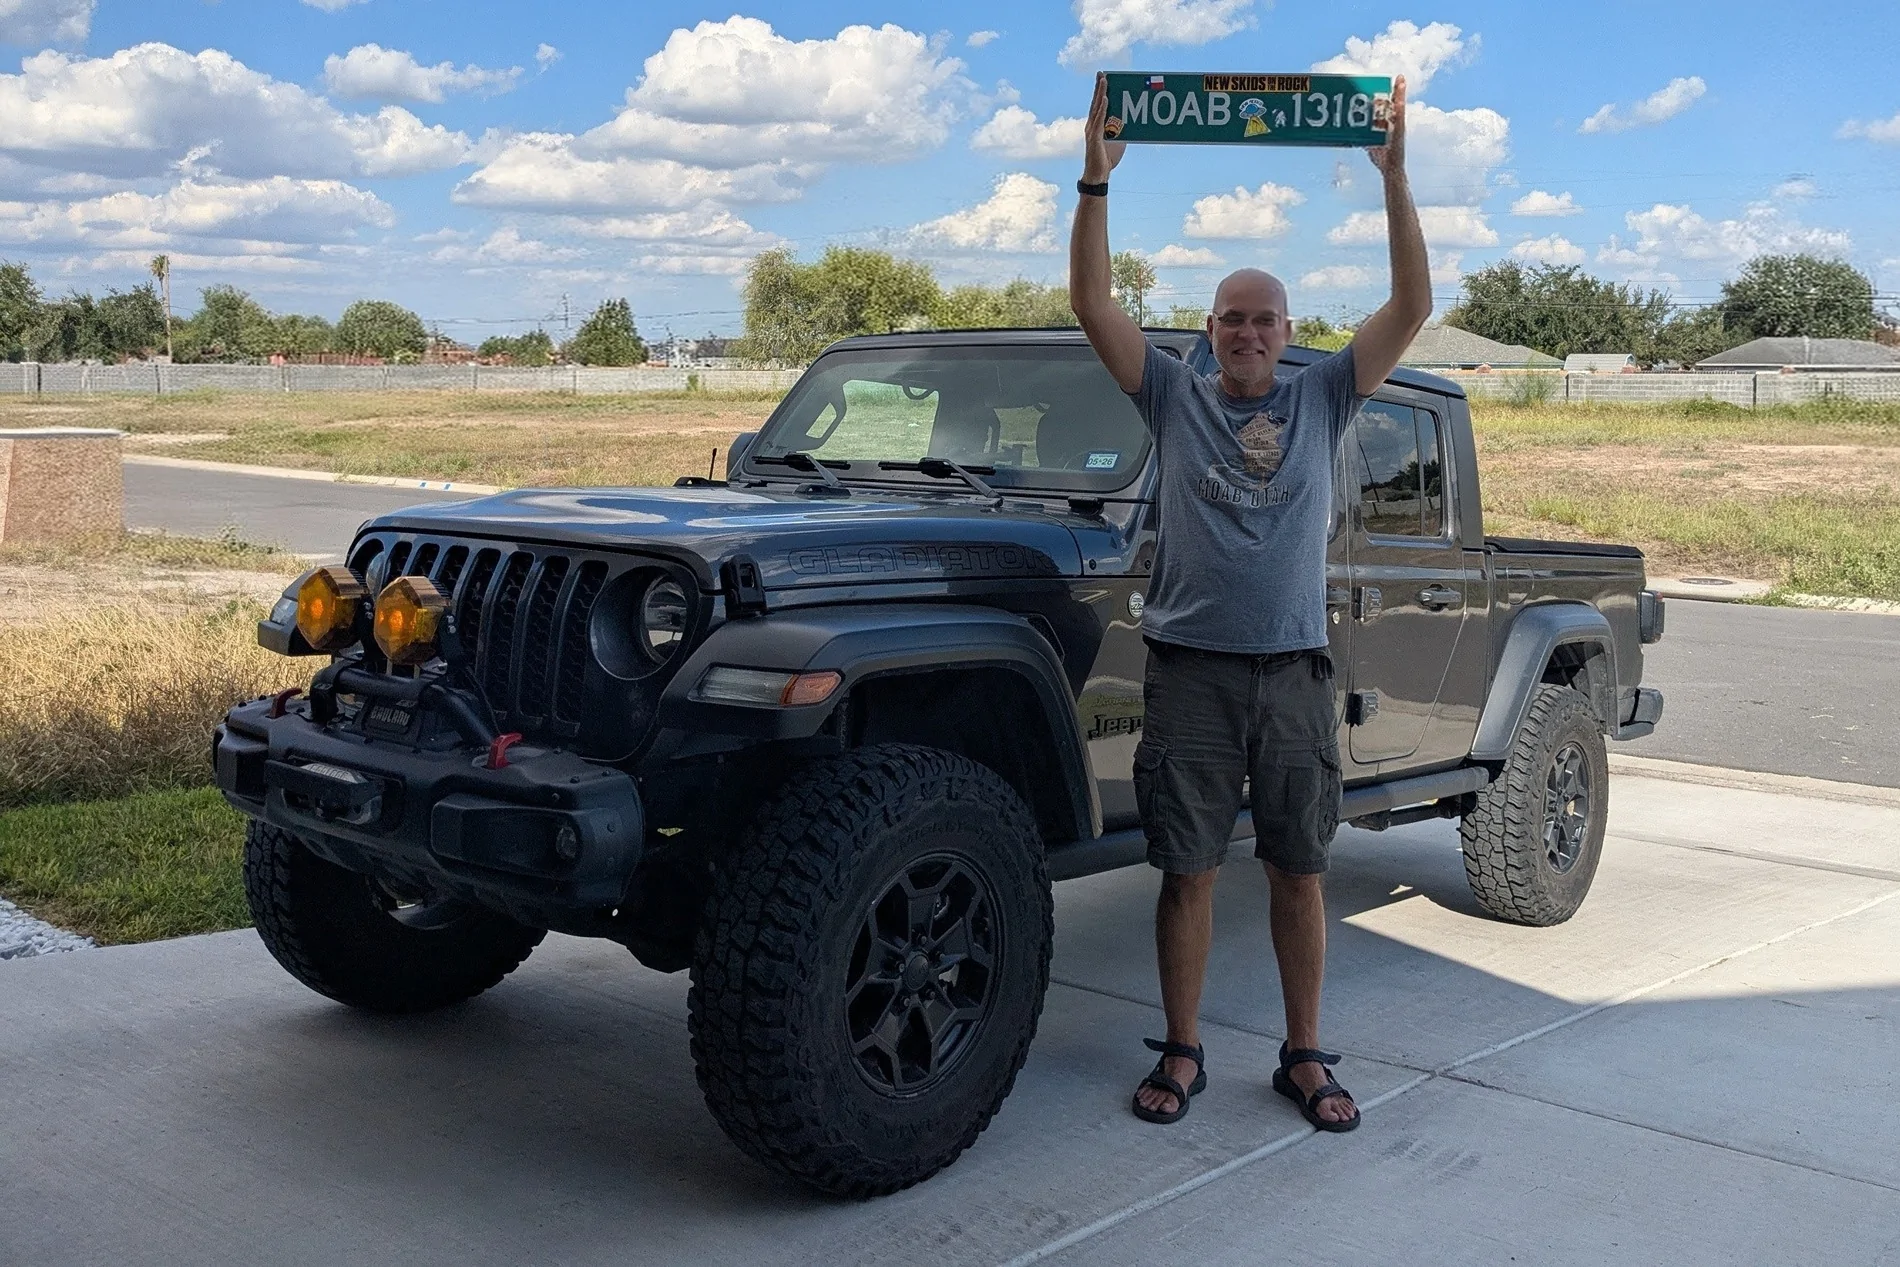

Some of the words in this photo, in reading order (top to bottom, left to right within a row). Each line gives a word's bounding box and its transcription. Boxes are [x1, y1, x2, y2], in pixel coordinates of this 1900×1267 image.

[1204, 75, 1230, 91] NEW
[1231, 76, 1266, 91] SKIDS
[1277, 75, 1308, 91] ROCK
[1121, 90, 1232, 126] MOAB
[1291, 92, 1369, 128] 1318
[1250, 485, 1290, 508] UTAH
[787, 545, 1054, 576] GLADIATOR
[1087, 713, 1144, 740] Jeep
